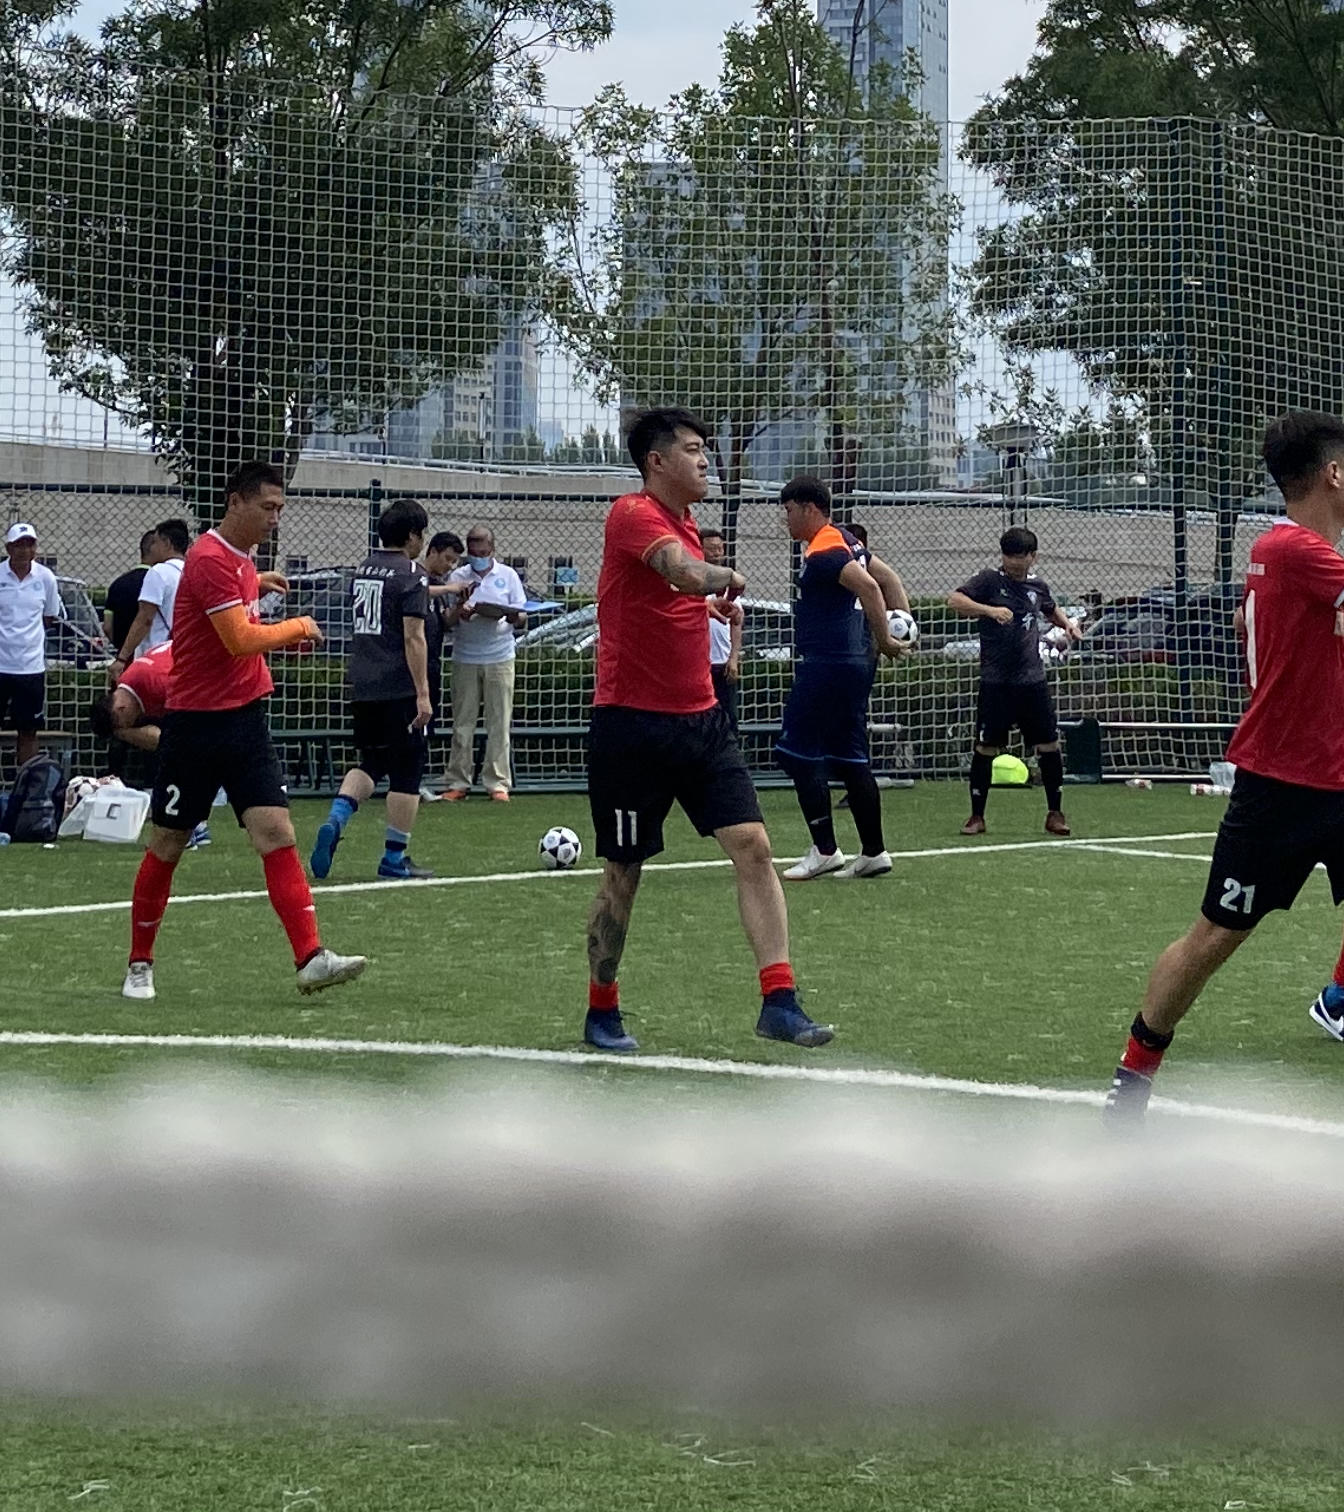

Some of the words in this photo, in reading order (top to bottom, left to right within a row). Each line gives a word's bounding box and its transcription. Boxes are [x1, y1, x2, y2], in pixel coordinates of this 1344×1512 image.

[352, 579, 384, 635] 20
[165, 784, 180, 816] 2
[614, 808, 637, 846] 11
[1219, 877, 1256, 914] 21
